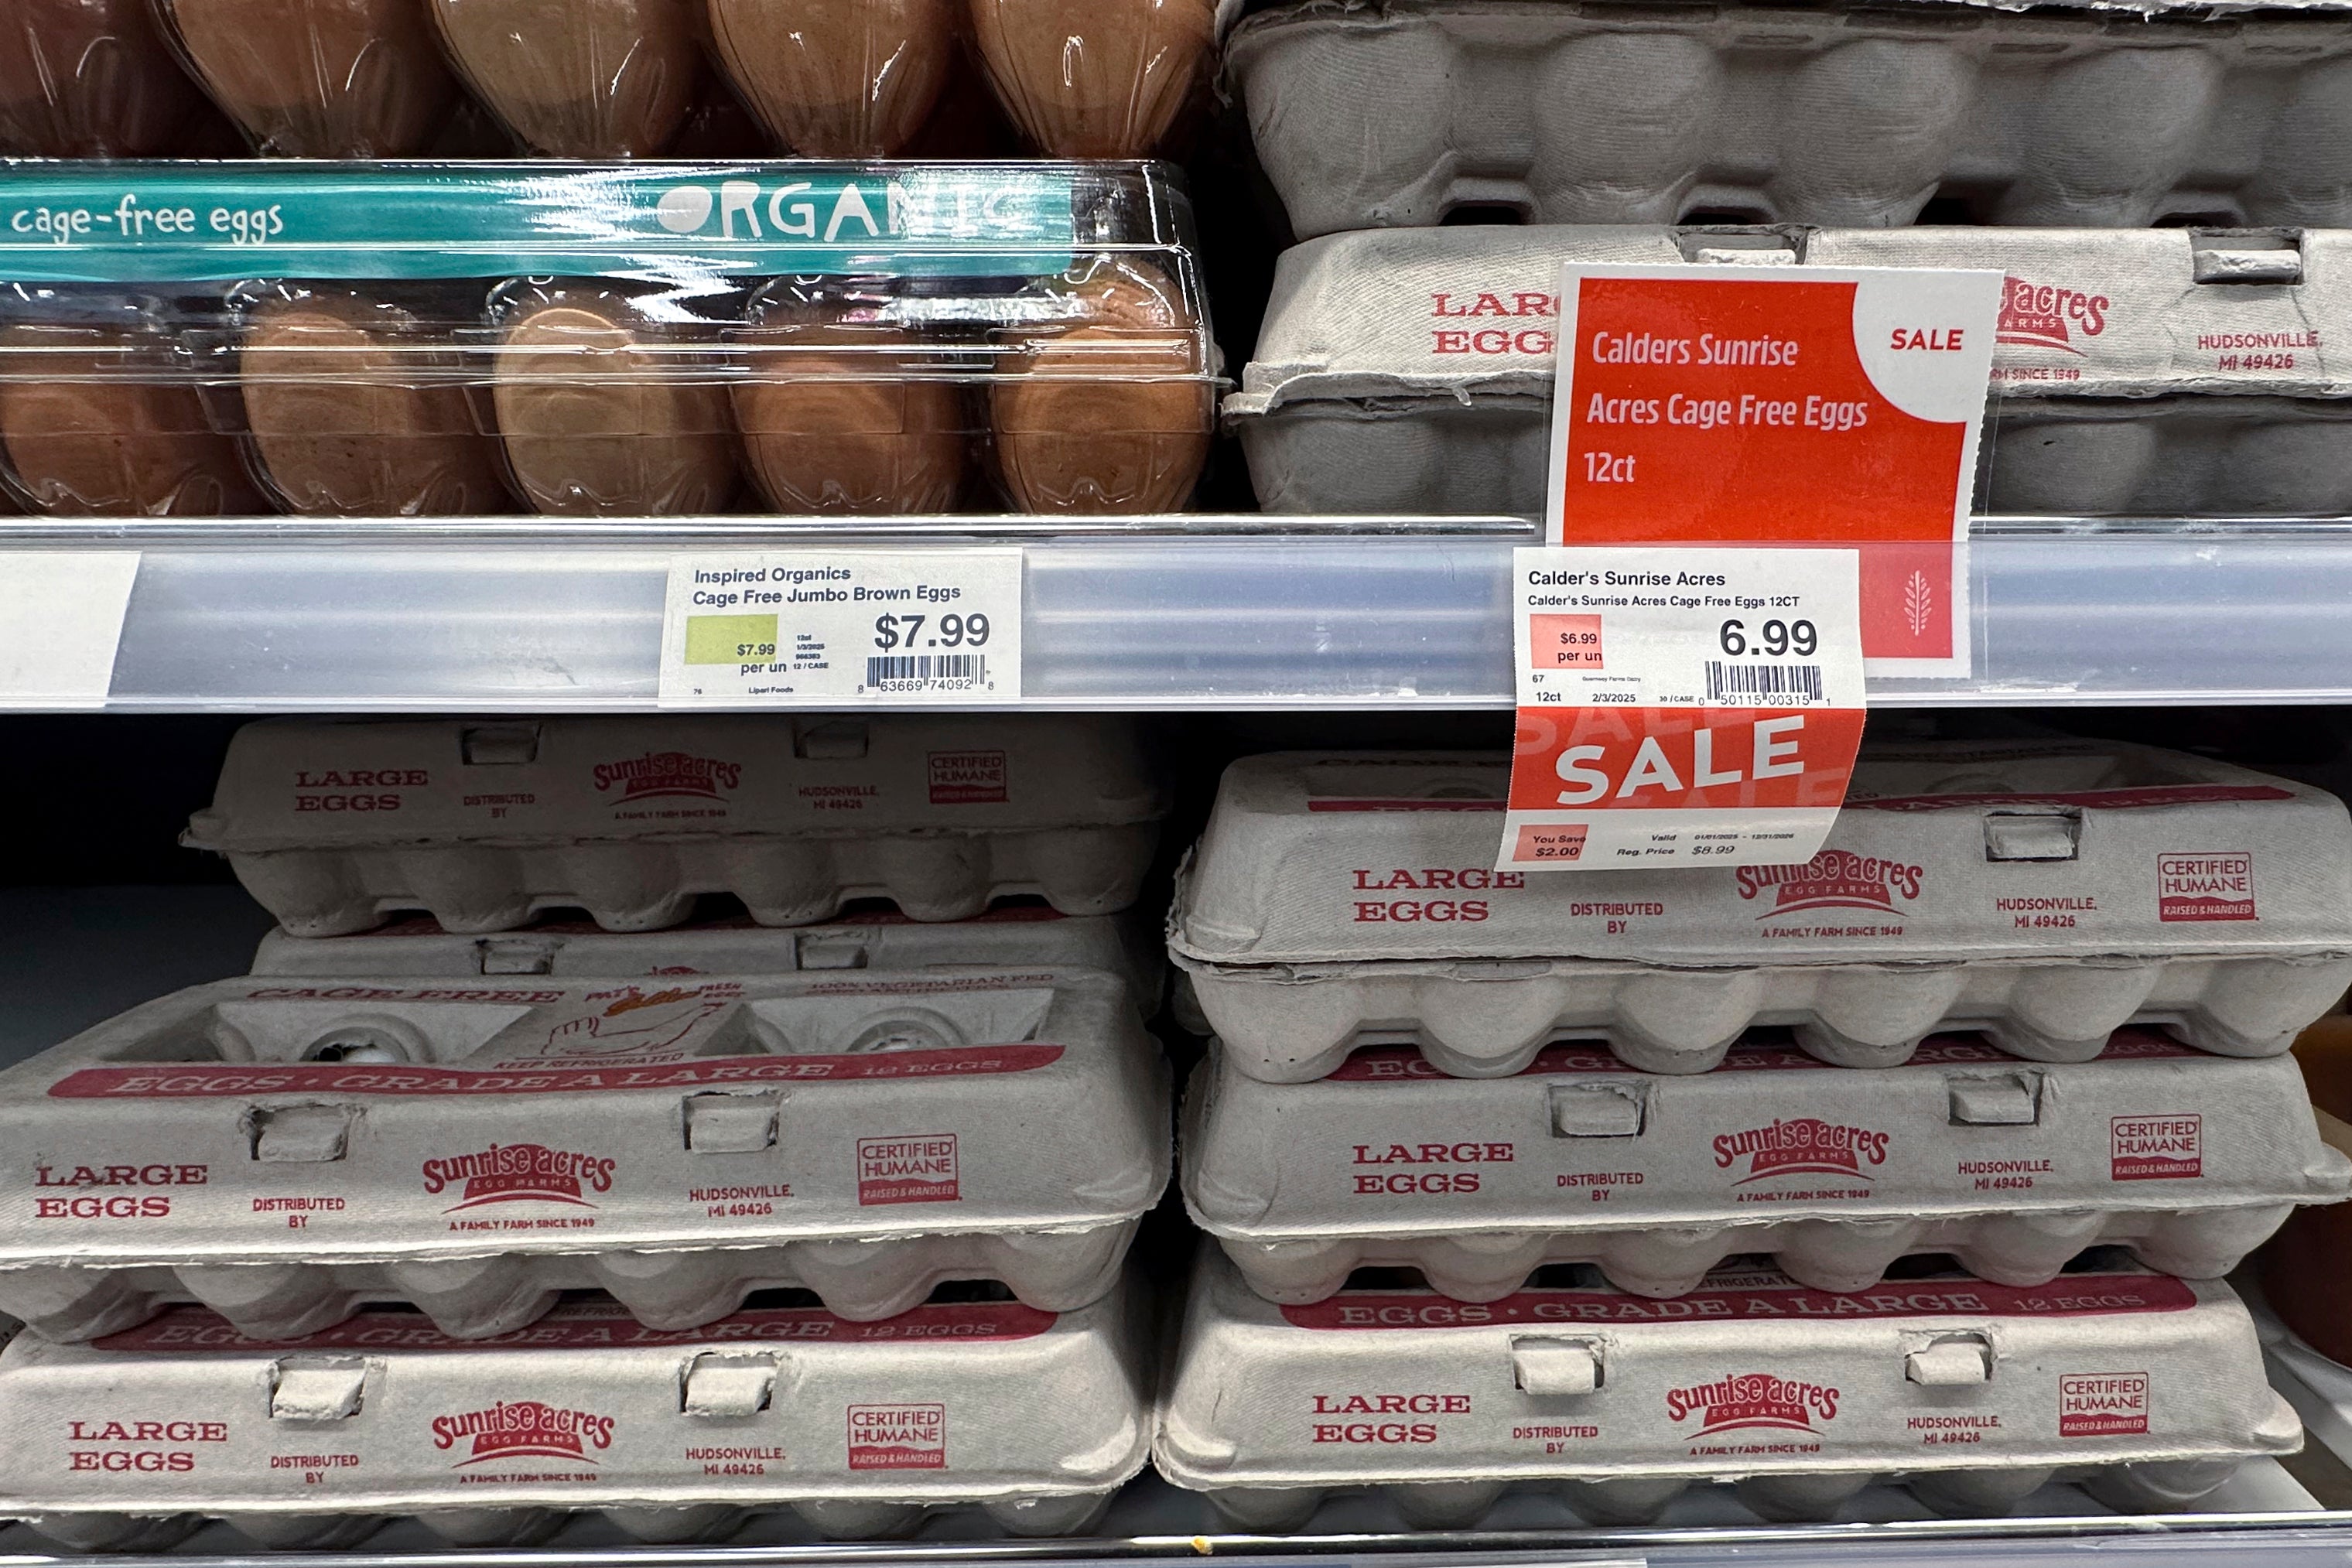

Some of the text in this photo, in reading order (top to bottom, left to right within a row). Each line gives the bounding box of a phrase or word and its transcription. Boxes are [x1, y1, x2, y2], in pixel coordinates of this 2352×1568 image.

[11, 193, 284, 244] cage-free eggs
[1431, 292, 1559, 316] LAR
[1892, 329, 1963, 350] SALE
[1592, 332, 1799, 367] Calders Sunrise
[2220, 354, 2293, 370] MI 49426
[1587, 394, 1868, 431] Acres Cage Free Eggs
[1584, 452, 1636, 483] 12ct
[695, 567, 851, 585] Inspired Organics
[1528, 571, 1725, 586] Calder's Sunrise Acres
[693, 586, 961, 607] Cage Free Jumbo Brown Eggs
[1528, 595, 1800, 610] Calder's Sunrise Acres Cage Free Eggs 12CT
[874, 613, 990, 653] $7.99
[1561, 632, 1597, 645] $6.99
[1719, 620, 1817, 657] 6.99
[737, 644, 775, 657] $7.99
[1557, 651, 1602, 664] per un
[740, 664, 787, 676] per un
[857, 678, 994, 693] 8 63669 74092 8
[1532, 675, 1544, 683] 67
[1536, 692, 1561, 702] 12ct
[1592, 693, 1636, 703] 2/3/2025
[1698, 697, 1704, 706] 0
[1720, 695, 1761, 705] 50115
[1769, 695, 1810, 706] 00315
[932, 757, 1002, 768] CERTIFIED
[1555, 714, 1804, 805] SALE
[296, 770, 429, 787] LARGE
[935, 770, 1000, 781] HUMANE
[295, 794, 401, 811] EGGS
[1535, 846, 1578, 858] $2.00
[1617, 848, 1641, 856] Reg.
[1691, 845, 1735, 855] $8.99
[2162, 860, 2248, 876] CERTIFIED
[1352, 869, 1524, 890] LARGE
[1844, 853, 1923, 900] acres
[2166, 877, 2247, 893] HUMANE
[1353, 900, 1489, 922] EGGS
[1571, 903, 1663, 916] DISTRIBUTED
[2163, 905, 2200, 916] RAISED
[2207, 904, 2252, 915] HANDLED
[1607, 921, 1627, 934] BY
[2015, 915, 2076, 928] MI 49426
[1762, 926, 1902, 938] A FAMILY FARM SINCE 1949
[247, 989, 566, 1003] CAGE FREE
[543, 1053, 684, 1071] REFRIGERATED
[107, 1061, 1003, 1092] EGGS GRADE A LARGE 12 EGGS
[2115, 1121, 2197, 1137] CERTIFIED
[862, 1141, 952, 1160] CERTIFIED
[1712, 1118, 1889, 1168] Sunrise acres
[2118, 1138, 2195, 1153] HUMANE
[1352, 1143, 1514, 1164] LARGE
[36, 1164, 208, 1187] LARGE
[422, 1143, 616, 1194] Sunrise acres
[865, 1159, 951, 1177] HUMANE
[2115, 1164, 2148, 1174] RAISED
[2155, 1163, 2197, 1173] HANDLED
[1352, 1173, 1480, 1194] EGGS
[36, 1196, 171, 1218] EGGS
[252, 1197, 345, 1212] DISTRIBUTED
[289, 1215, 308, 1228] BY
[1338, 1293, 2146, 1324] EGGS GRADE A LARGE 12 EGGS
[863, 1323, 997, 1337] 12 EGGS
[2063, 1379, 2145, 1395] CERTIFIED
[1312, 1395, 1470, 1414] LARGE
[1667, 1374, 1840, 1422] Sunrise acres
[2067, 1396, 2142, 1410] HUMANE
[70, 1422, 227, 1442] LARGE
[432, 1400, 614, 1450] Sunrise acres
[1513, 1426, 1598, 1440] DISTRIBUTED
[1312, 1424, 1437, 1443] EGGS
[1547, 1440, 1564, 1454] BY
[70, 1452, 195, 1472] EGGS
[704, 1464, 764, 1475] MI 49426
